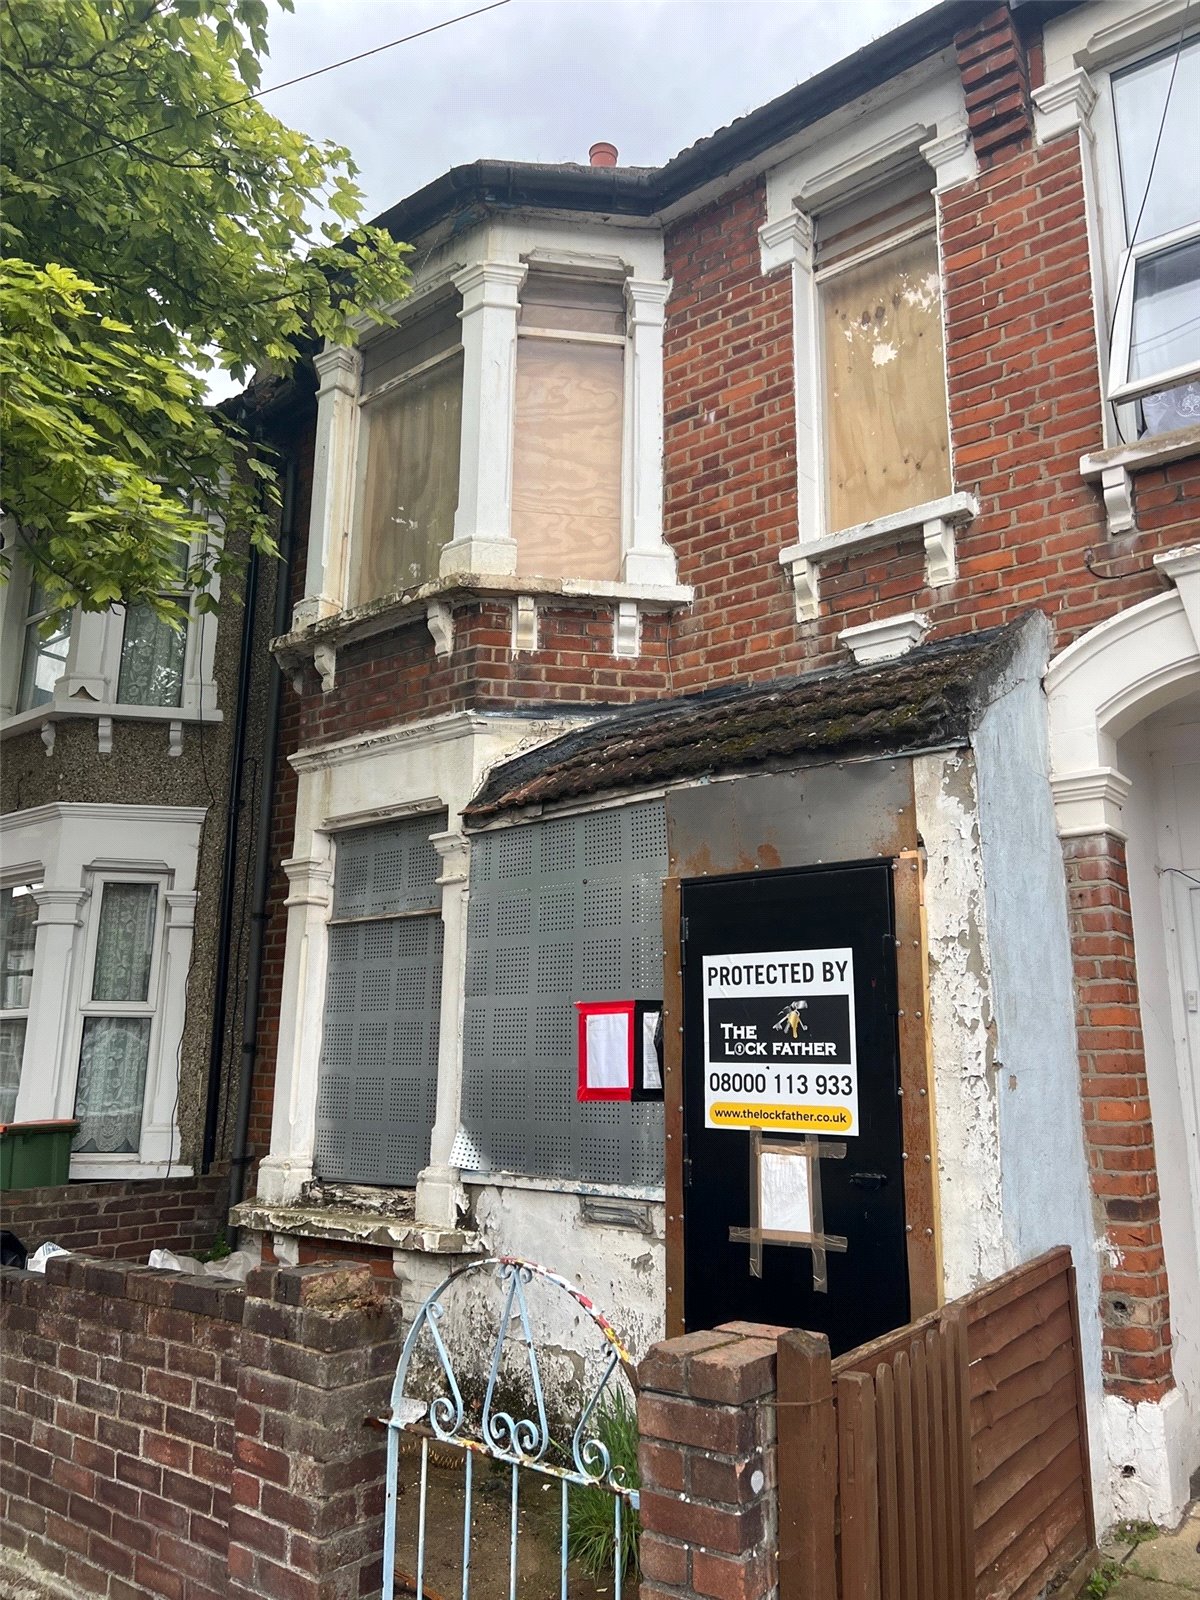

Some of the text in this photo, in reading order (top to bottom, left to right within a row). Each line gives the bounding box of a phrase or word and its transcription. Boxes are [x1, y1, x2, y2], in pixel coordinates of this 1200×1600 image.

[708, 960, 848, 986] PROTECTED BY
[720, 1023, 757, 1040] THE
[725, 1042, 837, 1056] LOCK FATHER
[709, 1072, 853, 1096] 08000 113 933
[715, 1109, 847, 1124] www.thelockfather.co.uk
